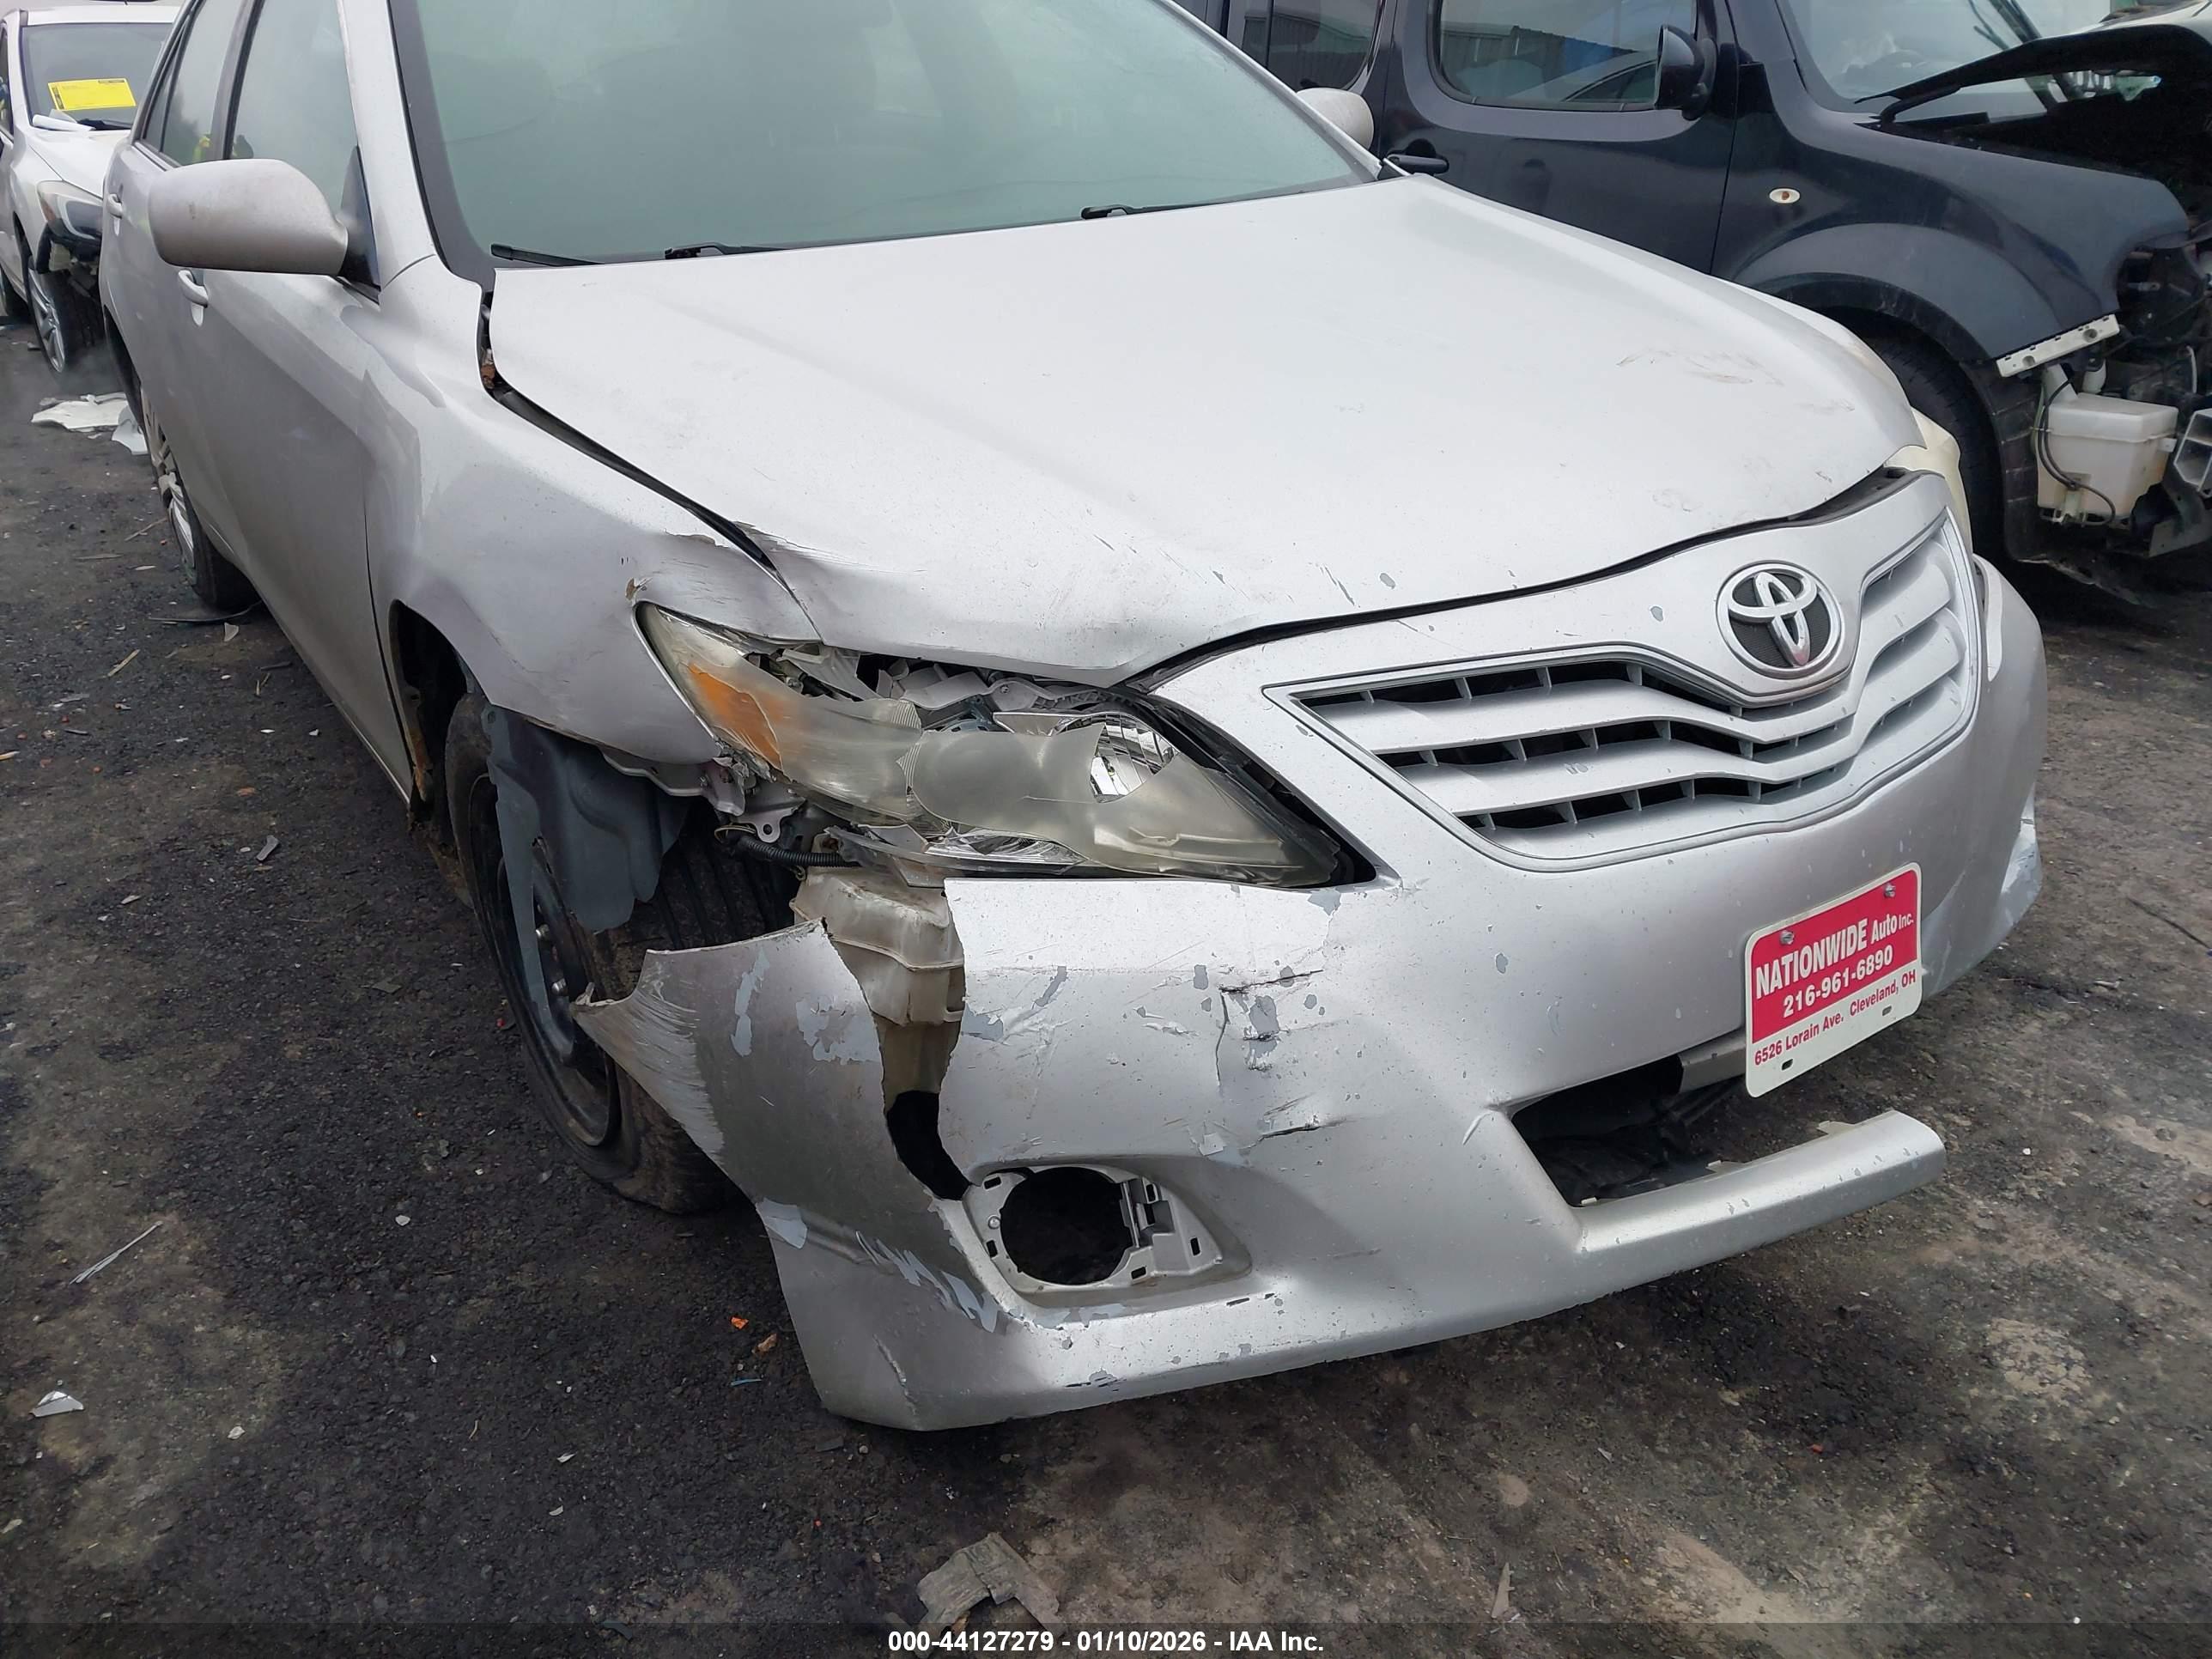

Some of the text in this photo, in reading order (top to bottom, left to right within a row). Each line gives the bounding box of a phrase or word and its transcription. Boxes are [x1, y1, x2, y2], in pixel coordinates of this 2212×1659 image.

[1755, 912, 1914, 1000] NATIONWIDE Auto Inc.
[1783, 944, 1893, 1018] 216-961-6890
[1754, 969, 1916, 1066] 6526 Lorain Ave. Cleveland, OH
